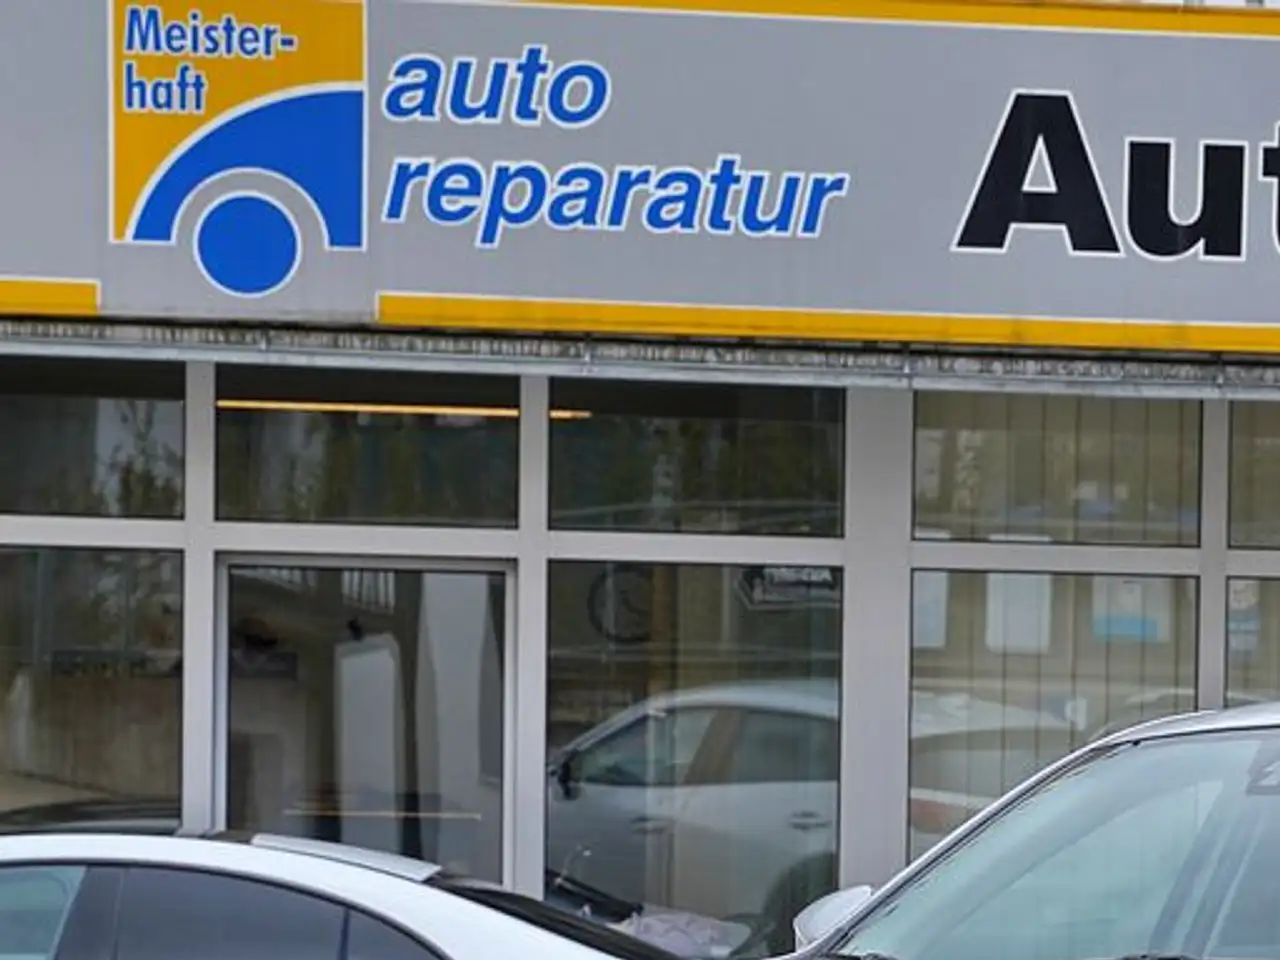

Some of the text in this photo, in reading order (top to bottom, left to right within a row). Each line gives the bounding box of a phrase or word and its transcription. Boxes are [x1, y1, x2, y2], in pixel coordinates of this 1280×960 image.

[125, 6, 297, 58] Meister-
[125, 61, 206, 111] haft
[382, 44, 611, 127] auto
[382, 154, 847, 247] reparatur
